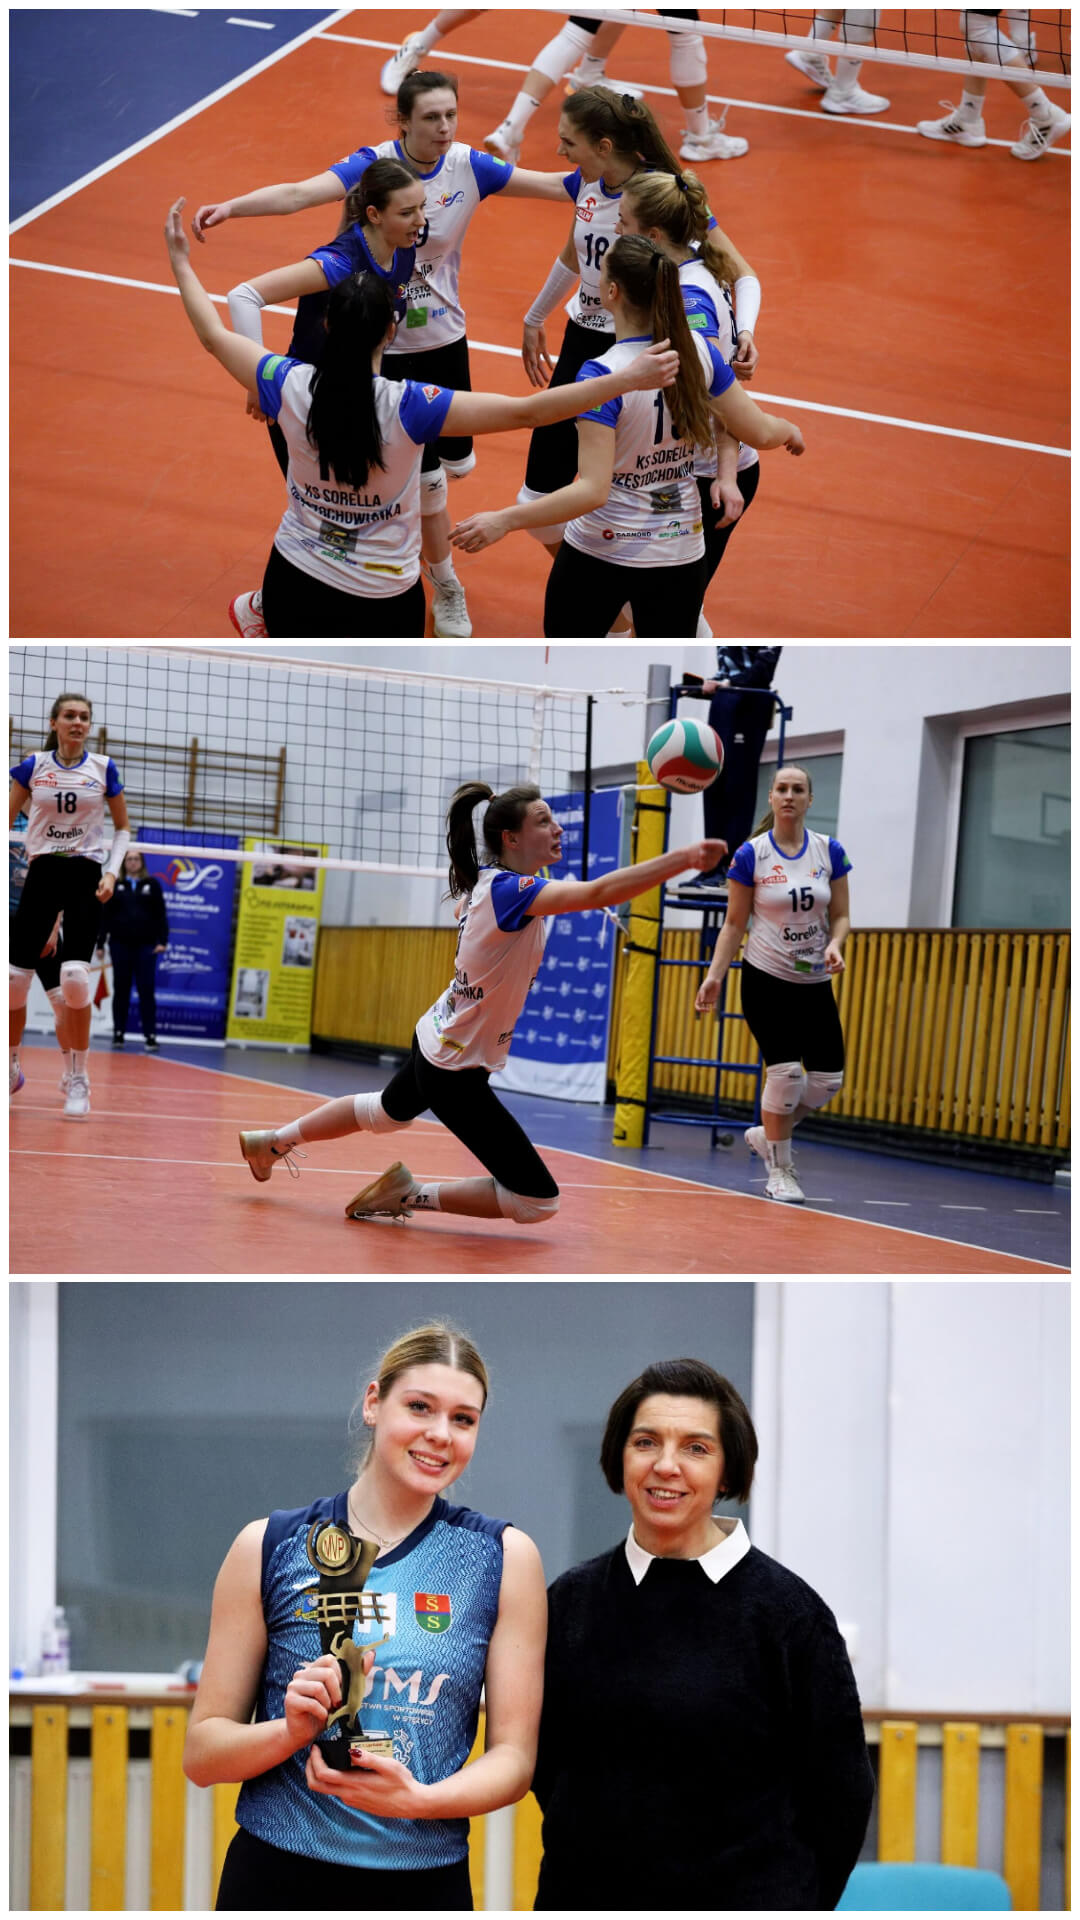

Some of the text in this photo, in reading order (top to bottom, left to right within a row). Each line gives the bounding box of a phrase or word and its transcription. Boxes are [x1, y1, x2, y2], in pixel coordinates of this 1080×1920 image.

[636, 454, 651, 470] KS
[323, 488, 382, 508] SORELLA
[54, 791, 78, 814] 18
[46, 824, 84, 840] Sorella
[788, 886, 815, 913] 15
[783, 925, 818, 942] Sorella
[323, 1533, 345, 1560] MVP
[362, 1666, 450, 1705] SMS
